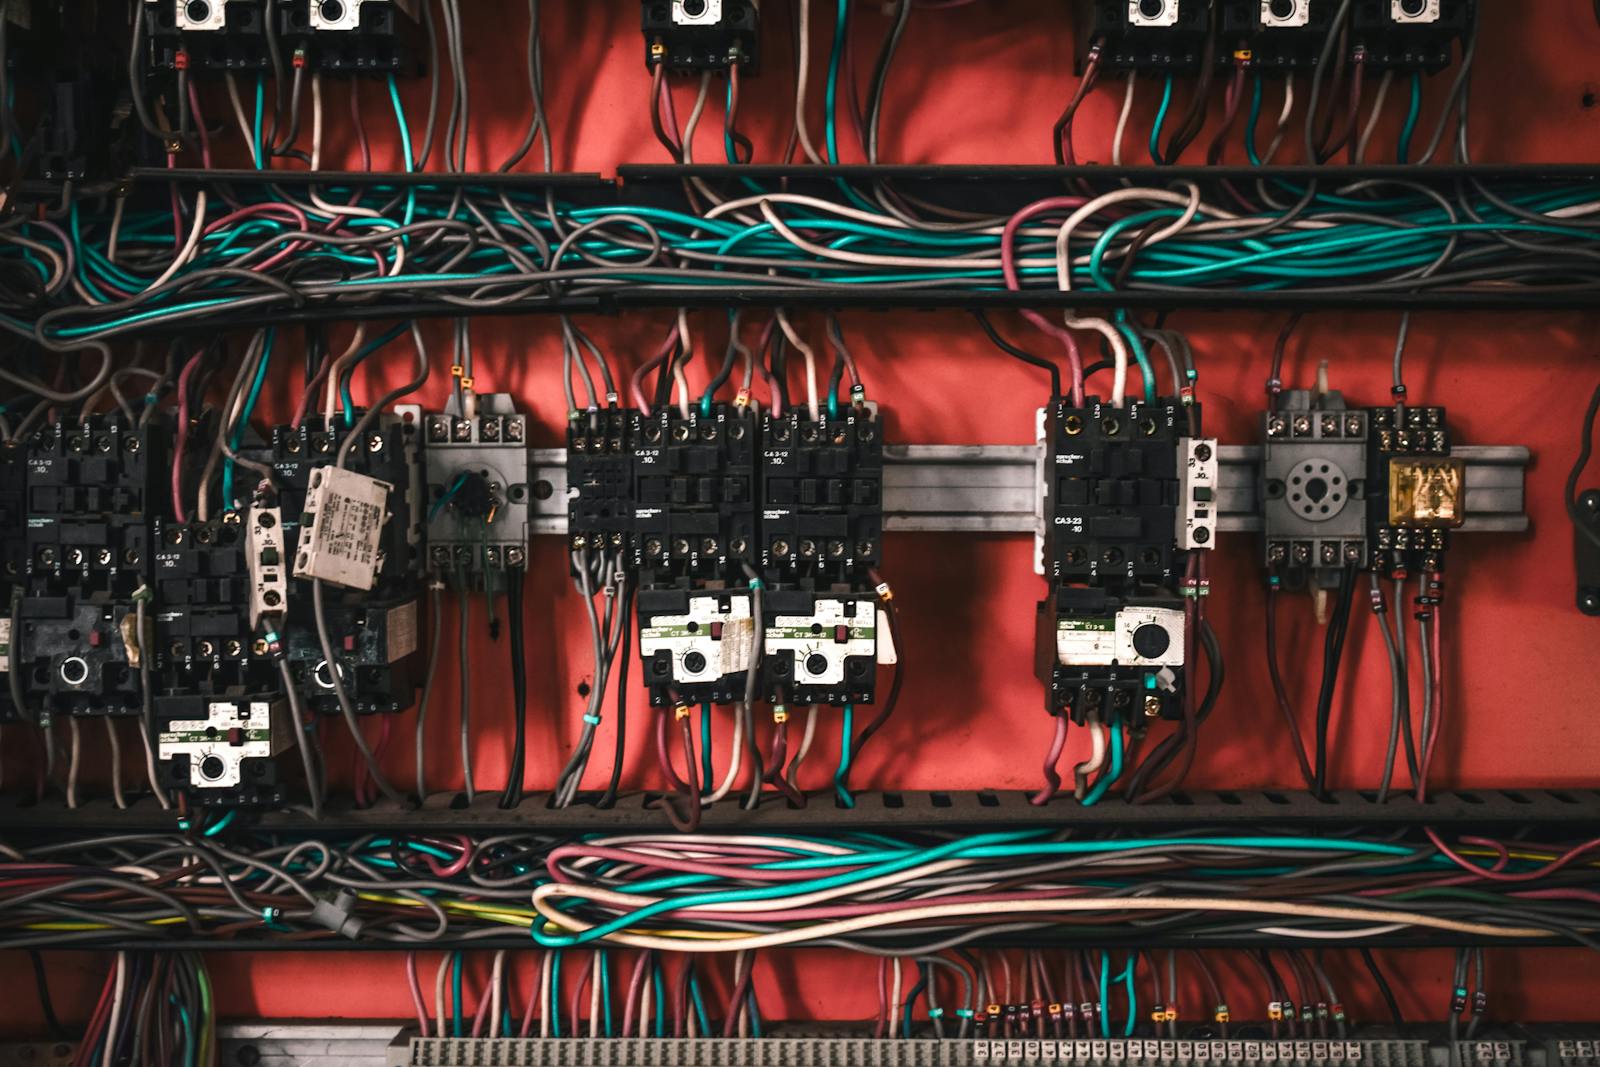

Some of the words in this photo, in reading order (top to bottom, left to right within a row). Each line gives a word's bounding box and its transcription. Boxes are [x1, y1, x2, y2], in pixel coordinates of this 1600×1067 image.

[978, 1042, 987, 1055] 36
[995, 1043, 1004, 1056] 37
[1011, 1042, 1020, 1055] 39
[1028, 1042, 1037, 1056] 40
[1045, 1042, 1054, 1056] 41
[1063, 1042, 1071, 1056] 42
[1079, 1042, 1088, 1056] 44
[1095, 1043, 1104, 1056] 45
[1112, 1043, 1121, 1057] 46
[1131, 1041, 1140, 1055] 47
[1148, 1042, 1156, 1055] 47
[1164, 1043, 1173, 1056] 48
[1181, 1042, 1190, 1056] 49
[1198, 1043, 1207, 1057] 50
[1215, 1043, 1223, 1057] 50
[1231, 1043, 1240, 1057] 51
[1248, 1045, 1257, 1058] 52
[1282, 1043, 1291, 1057] 54
